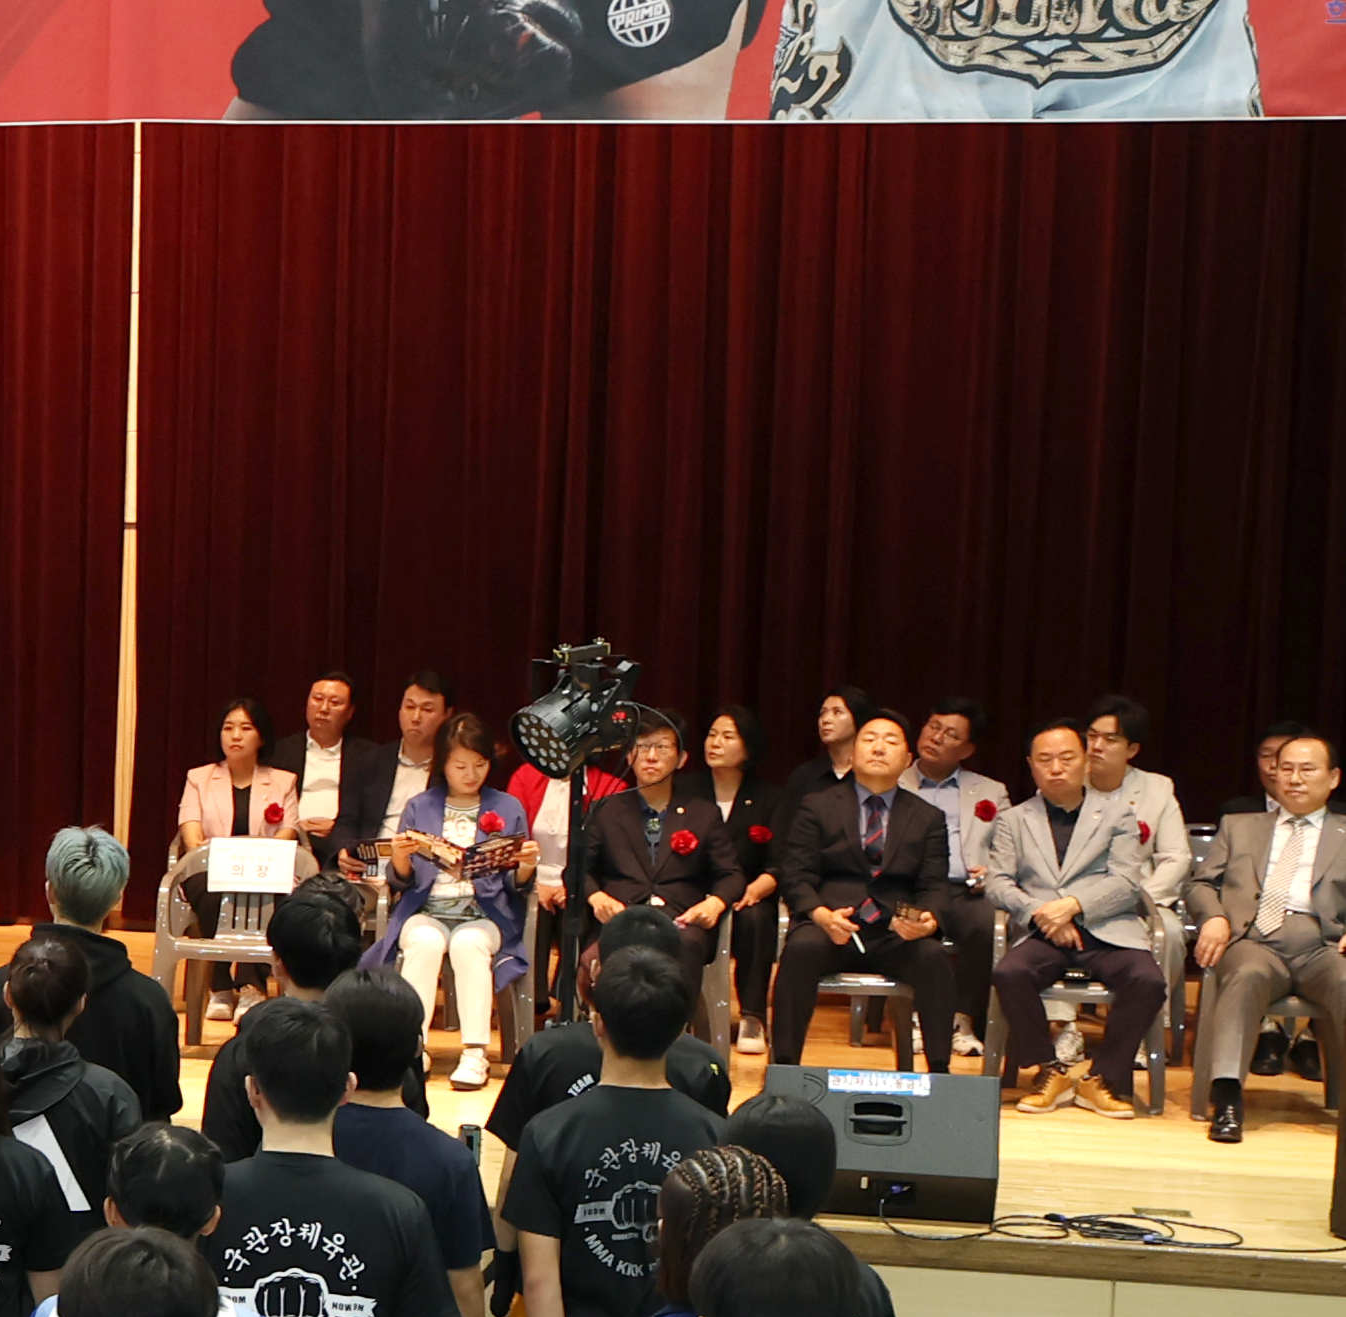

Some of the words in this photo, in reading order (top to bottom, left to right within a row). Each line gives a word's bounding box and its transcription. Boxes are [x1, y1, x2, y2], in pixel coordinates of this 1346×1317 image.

[614, 2, 666, 31] PRIMO
[567, 1073, 595, 1097] TEAM
[584, 1232, 614, 1268] MMA
